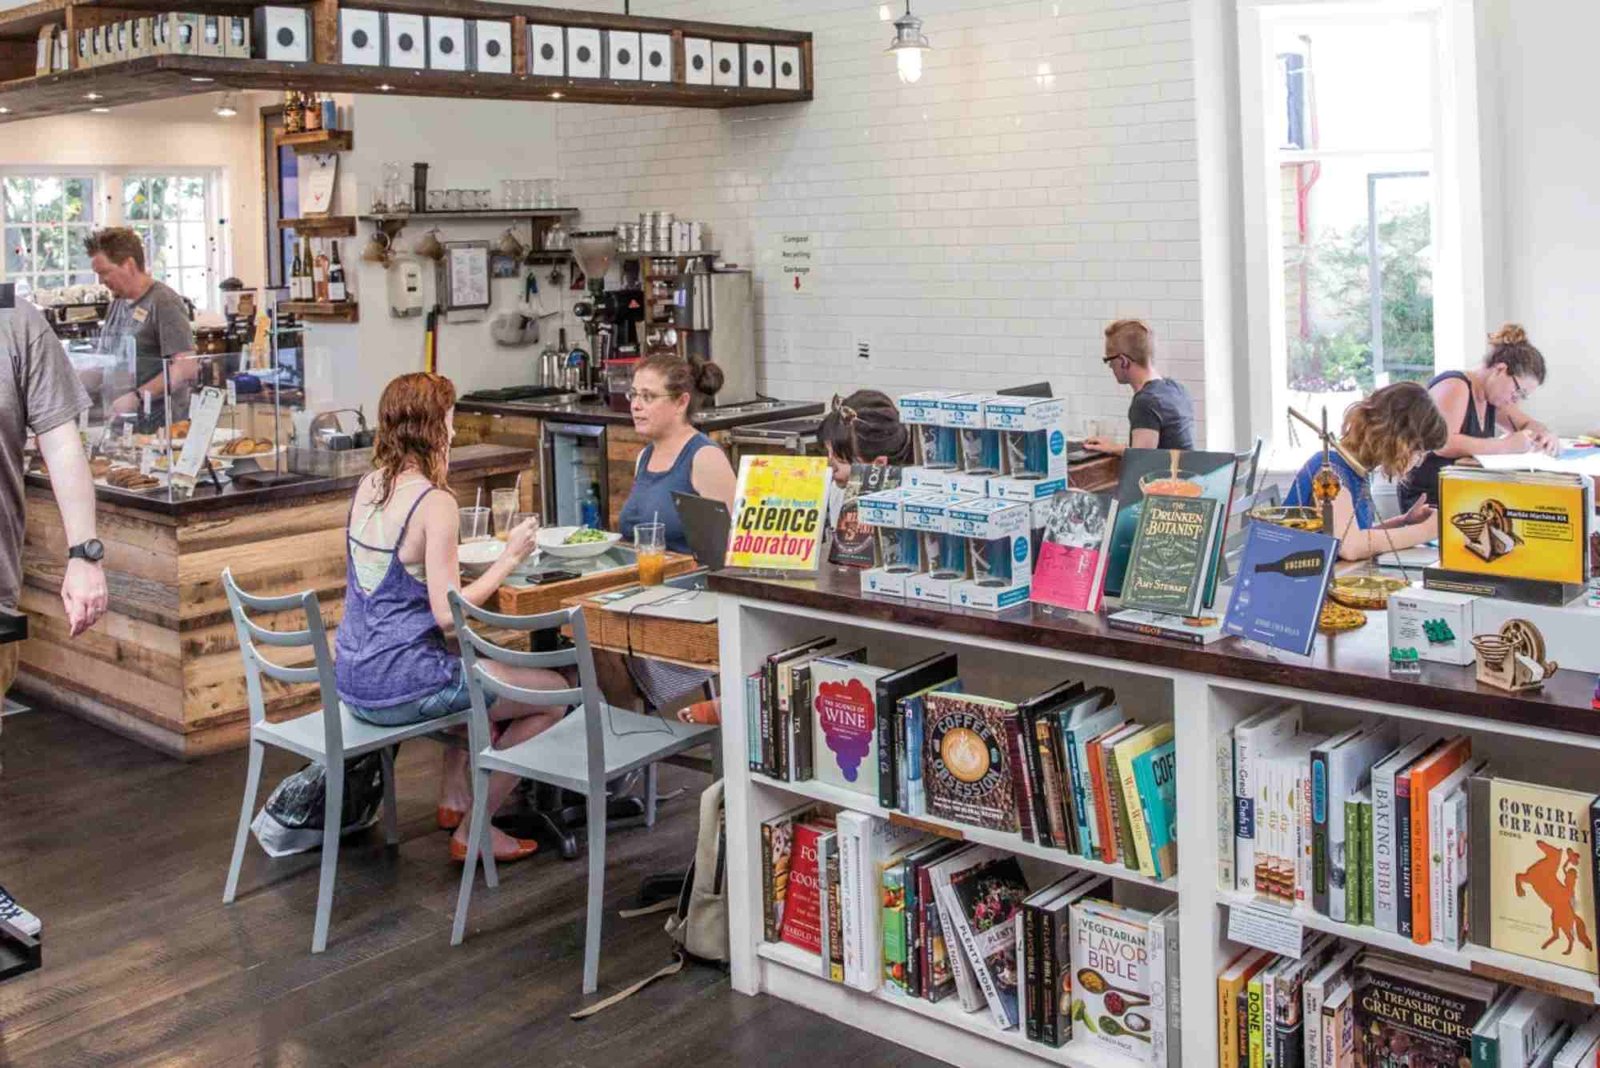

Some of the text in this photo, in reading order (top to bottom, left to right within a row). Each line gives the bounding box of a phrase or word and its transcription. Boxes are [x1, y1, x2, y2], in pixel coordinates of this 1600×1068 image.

[1145, 521, 1204, 540] BOTANIST
[1151, 508, 1205, 523] DRUNKEN
[729, 529, 815, 562] aboratory
[793, 717, 801, 734] TEA
[825, 706, 866, 729] WINE
[938, 714, 991, 741] COFFEE
[933, 758, 1001, 797] OBSESSION
[1499, 797, 1577, 826] COWGIRL
[1499, 813, 1590, 844] CREAMERY
[801, 846, 818, 862] FO
[1376, 788, 1391, 911] BAKING BIBLE
[789, 871, 820, 890] COOK
[940, 911, 962, 978] OTTOLENGHI
[987, 925, 1016, 945] PLENTY
[1081, 918, 1146, 946] VEGETARIAN
[959, 924, 996, 999] PLENTY MORE
[1077, 929, 1148, 966] FLAVOR
[1043, 960, 1052, 985] BIBLE
[1088, 951, 1138, 982] BIBLE
[1249, 992, 1261, 1034] DONE.
[1362, 996, 1473, 1039] GREAT RECIPES
[1372, 988, 1463, 1022] A TREASURY OF
[1264, 1024, 1272, 1048] CREAM
[1325, 1035, 1334, 1066] Cooking
